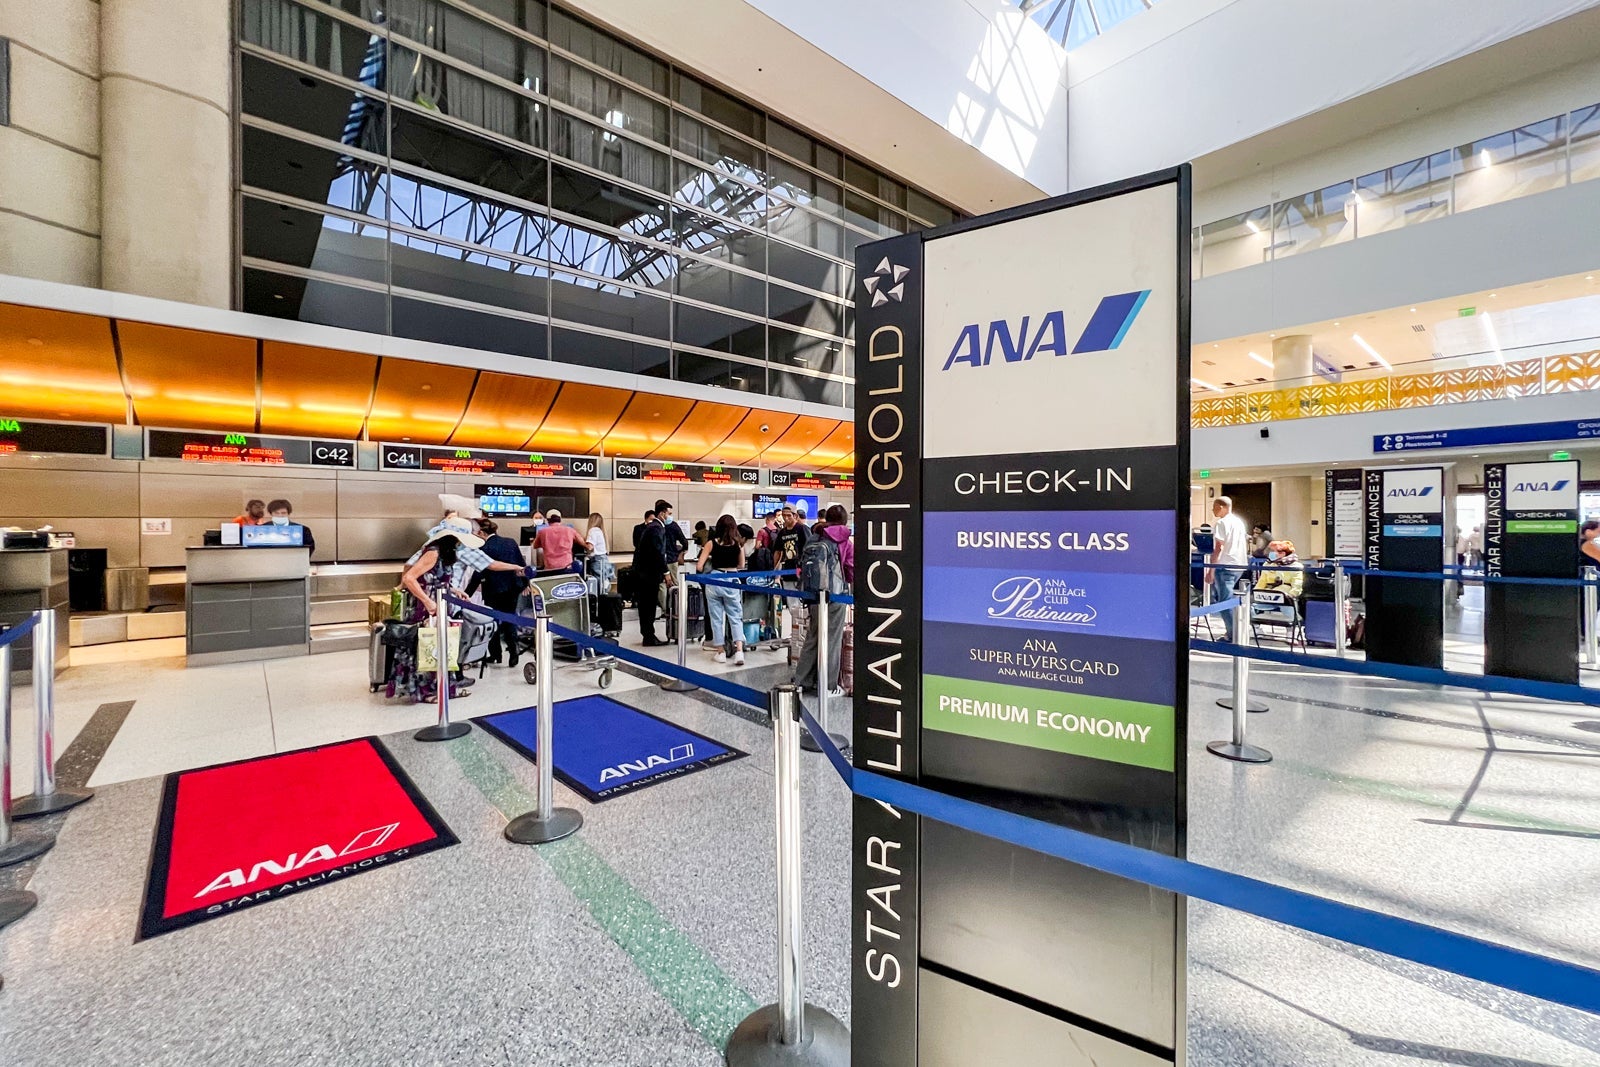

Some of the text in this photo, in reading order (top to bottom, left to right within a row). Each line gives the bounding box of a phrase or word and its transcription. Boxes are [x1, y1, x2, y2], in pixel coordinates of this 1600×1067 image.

[942, 310, 1067, 371] ANA
[867, 325, 904, 490] GOLD
[0, 419, 20, 431] NA
[224, 434, 246, 445] ANA
[315, 447, 349, 461] C42
[387, 451, 415, 465] C41
[572, 461, 594, 473] C40
[618, 465, 638, 475] C39
[742, 472, 757, 481] C38
[773, 474, 787, 483] C37
[954, 467, 1132, 495] CHECK-IN
[1387, 488, 1417, 497] ANA
[1512, 481, 1549, 492] ANA
[1488, 480, 1502, 544] ALLIANCE
[1368, 485, 1380, 571] TAR ALLIANCE
[957, 531, 1130, 551] BUSINESS CLASS
[1044, 579, 1066, 587] ANA
[988, 576, 1097, 623] Platinum
[1044, 587, 1087, 597] MILEAGE
[1044, 596, 1069, 605] CLUB
[1023, 638, 1057, 653] ANA
[969, 648, 1119, 676] SUPER FLYERS CARD
[998, 667, 1084, 685] ANA MILEAGE CLUB
[939, 695, 1151, 744] PREMIUM ECONOMY
[600, 755, 672, 783] ANA
[598, 784, 630, 797] STAR
[192, 844, 338, 899] ANA
[206, 854, 388, 914] STAR ALLIANCE
[866, 836, 901, 988] STAR
